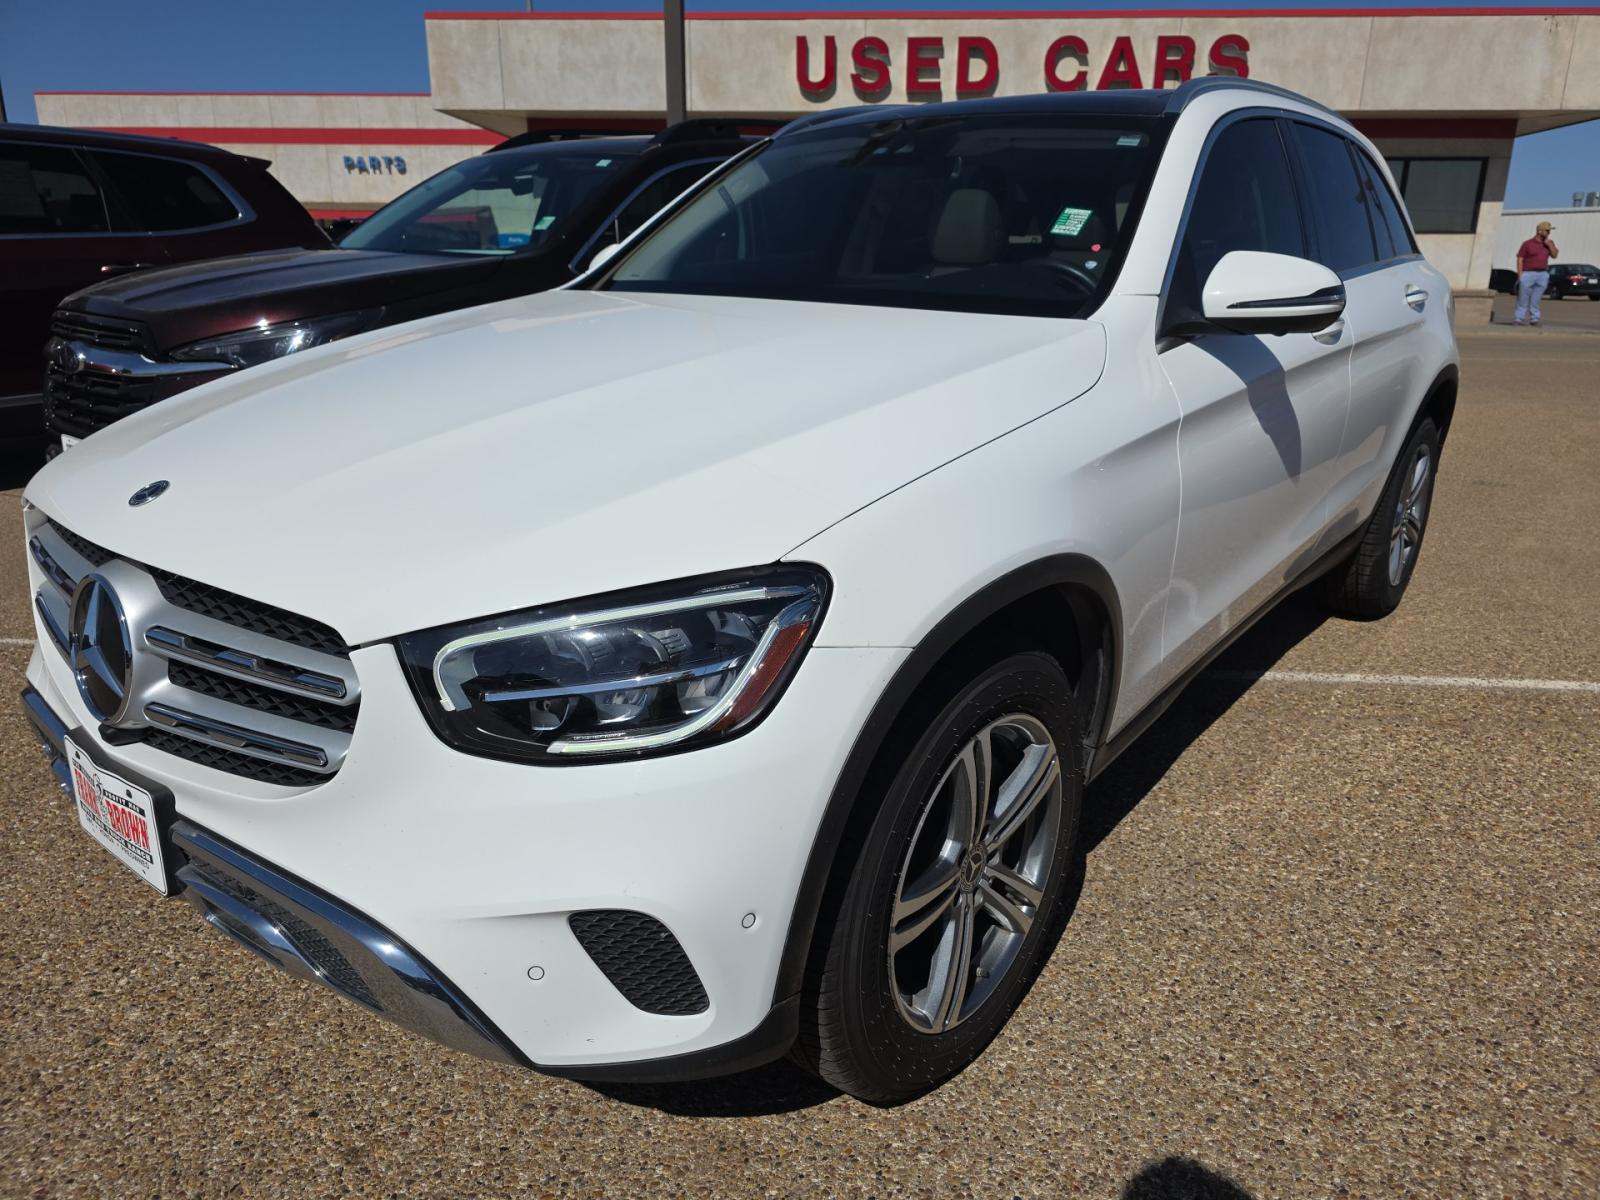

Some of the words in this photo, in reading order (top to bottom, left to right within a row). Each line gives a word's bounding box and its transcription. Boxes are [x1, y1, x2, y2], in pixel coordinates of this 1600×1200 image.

[796, 35, 1000, 96] USED
[1045, 34, 1250, 93] CARS
[343, 155, 407, 175] PARTS
[105, 800, 151, 853] BROWN
